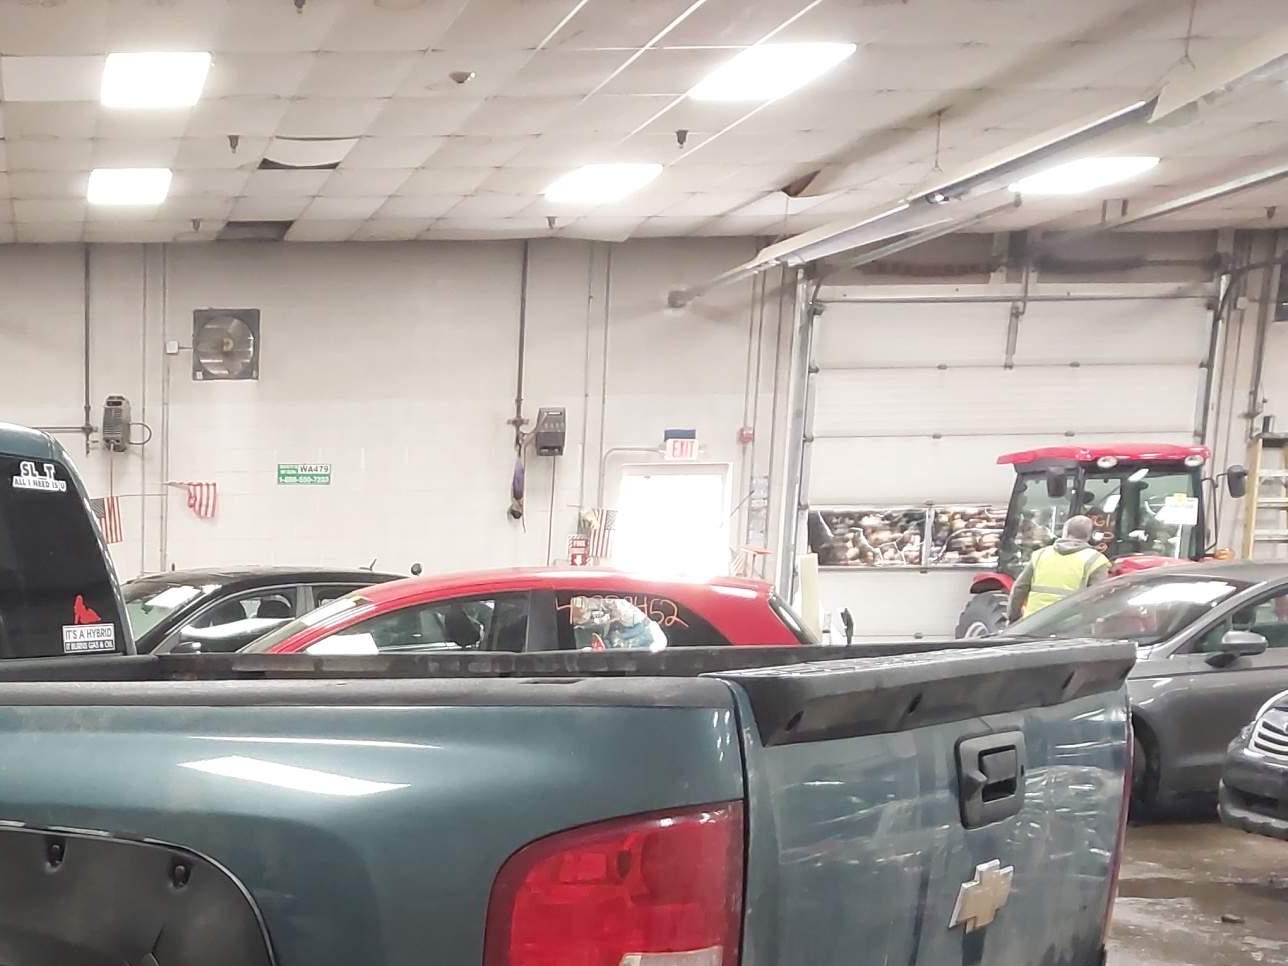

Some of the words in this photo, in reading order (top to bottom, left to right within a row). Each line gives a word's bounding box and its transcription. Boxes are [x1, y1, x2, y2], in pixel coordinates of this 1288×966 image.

[672, 440, 695, 458] EXIT
[300, 465, 329, 473] WA479
[14, 478, 27, 486] ALL
[33, 479, 50, 488] NEED
[52, 480, 59, 489] IS
[79, 630, 85, 639] A
[87, 627, 112, 638] HYBRID
